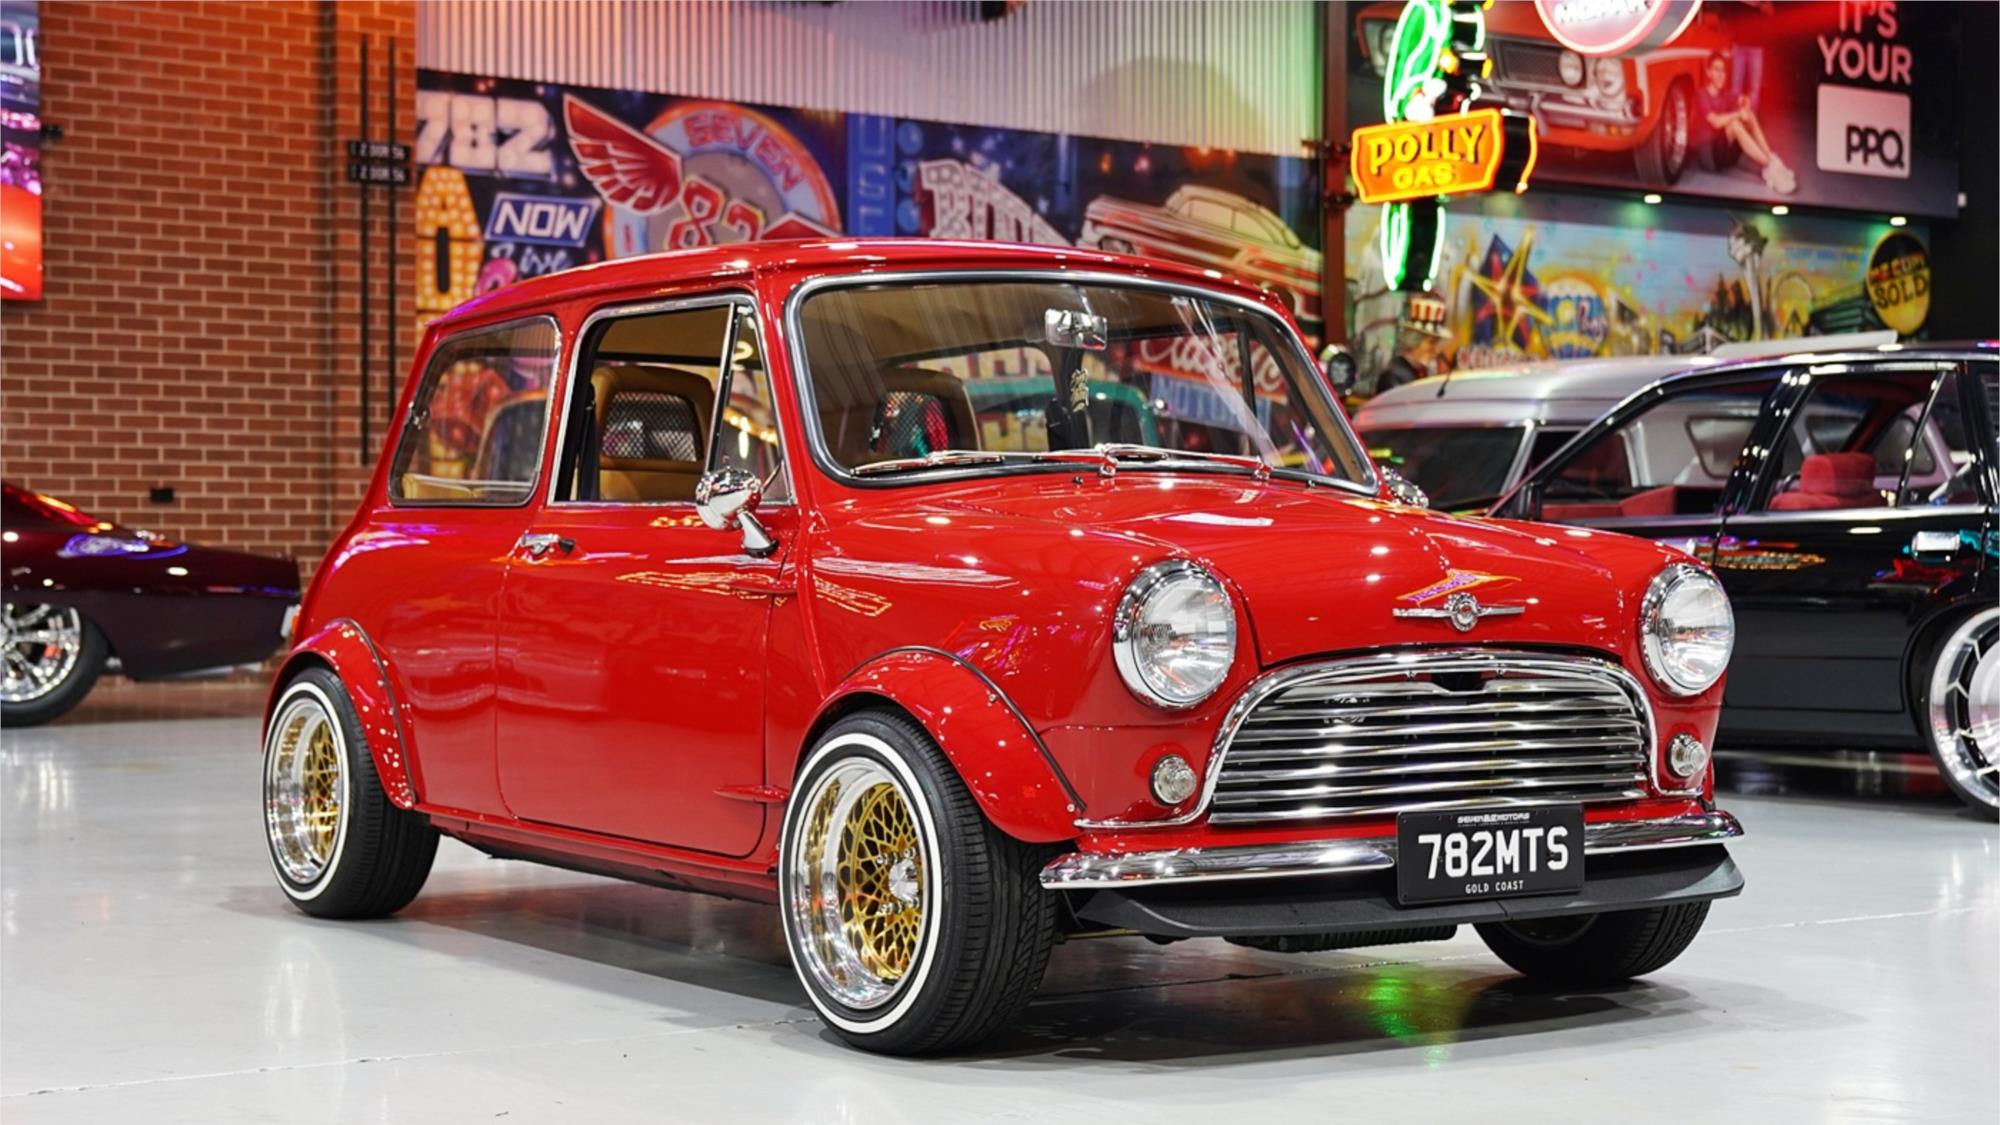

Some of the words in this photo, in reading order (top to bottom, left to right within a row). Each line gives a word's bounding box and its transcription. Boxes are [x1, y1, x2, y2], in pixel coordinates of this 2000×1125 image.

[1839, 1, 1898, 39] IT'S
[1817, 35, 1912, 85] YOUR
[417, 91, 557, 181] 782
[683, 108, 806, 193] SEVEN
[1367, 123, 1484, 176] POLLY
[1846, 124, 1904, 169] PPQ
[1392, 161, 1454, 190] GAS
[494, 200, 590, 241] NOW
[1874, 275, 1927, 309] SOLD
[1418, 826, 1569, 880] 782MTS
[1465, 882, 1490, 895] GOLD
[1495, 880, 1525, 892] COAST
